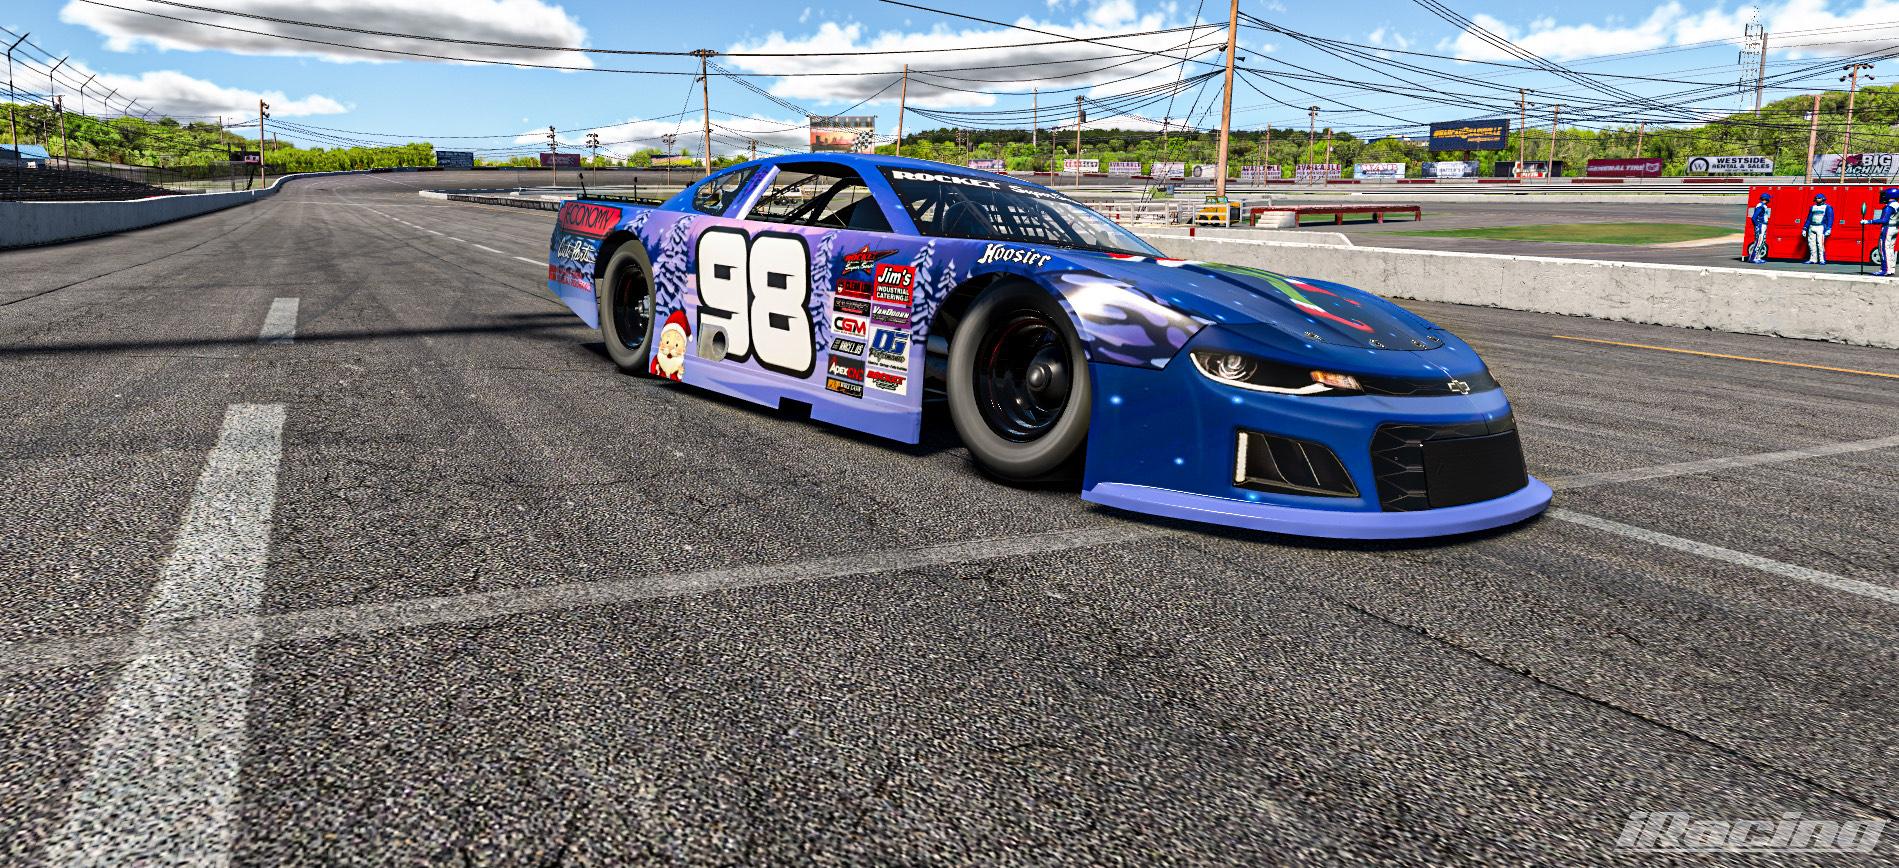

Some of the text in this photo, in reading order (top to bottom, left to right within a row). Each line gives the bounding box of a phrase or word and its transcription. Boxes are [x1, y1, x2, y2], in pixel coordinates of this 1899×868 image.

[1862, 153, 1893, 167] BIG
[892, 170, 1001, 190] ROCKET
[977, 243, 1052, 267] Hoosier
[877, 267, 912, 286] Jim's
[876, 286, 910, 296] INDUSTRIAL
[876, 292, 904, 302] CATERING
[696, 227, 815, 377] 98
[833, 316, 867, 336] CGM
